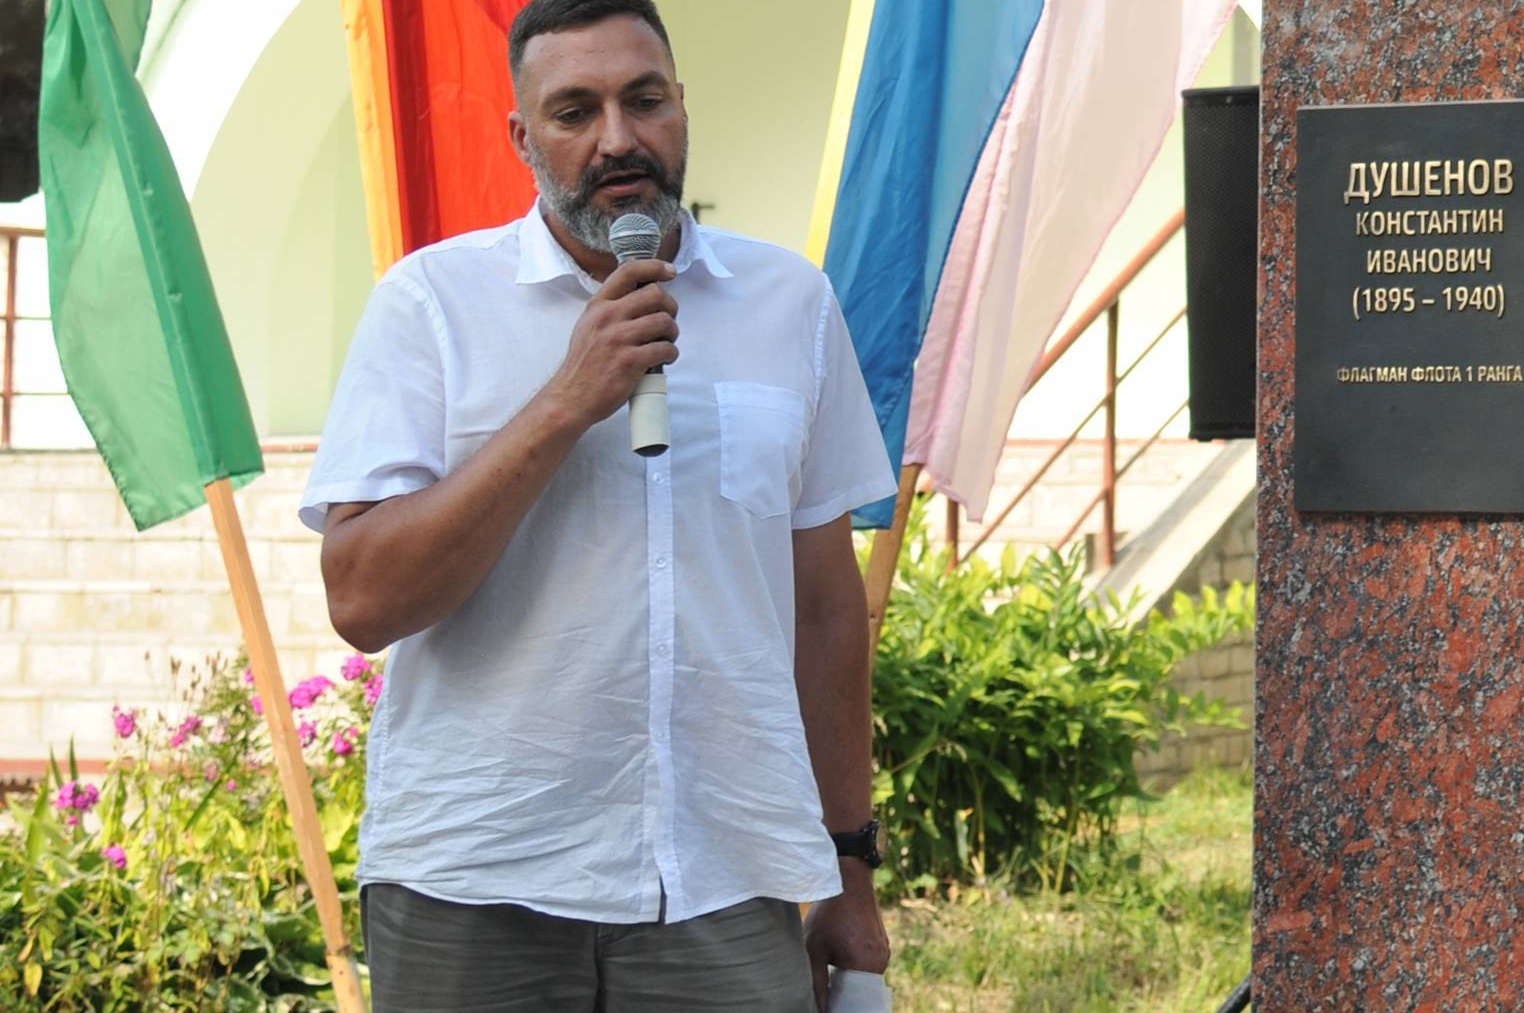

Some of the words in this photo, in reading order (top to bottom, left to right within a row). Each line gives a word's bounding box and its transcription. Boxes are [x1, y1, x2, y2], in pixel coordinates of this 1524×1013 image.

[1343, 158, 1513, 204] ДУШЕНОВ
[1355, 208, 1505, 236] КОНСТАНТИН
[1366, 247, 1492, 274] ИВАНОВИЧ
[1352, 286, 1416, 320] (1895
[1441, 283, 1505, 318] 1940)
[1336, 366, 1408, 383] ФЛАГМАН
[1410, 365, 1463, 383] ФЛОТА
[1465, 365, 1473, 382] 1
[1477, 364, 1524, 383] РАНГА
